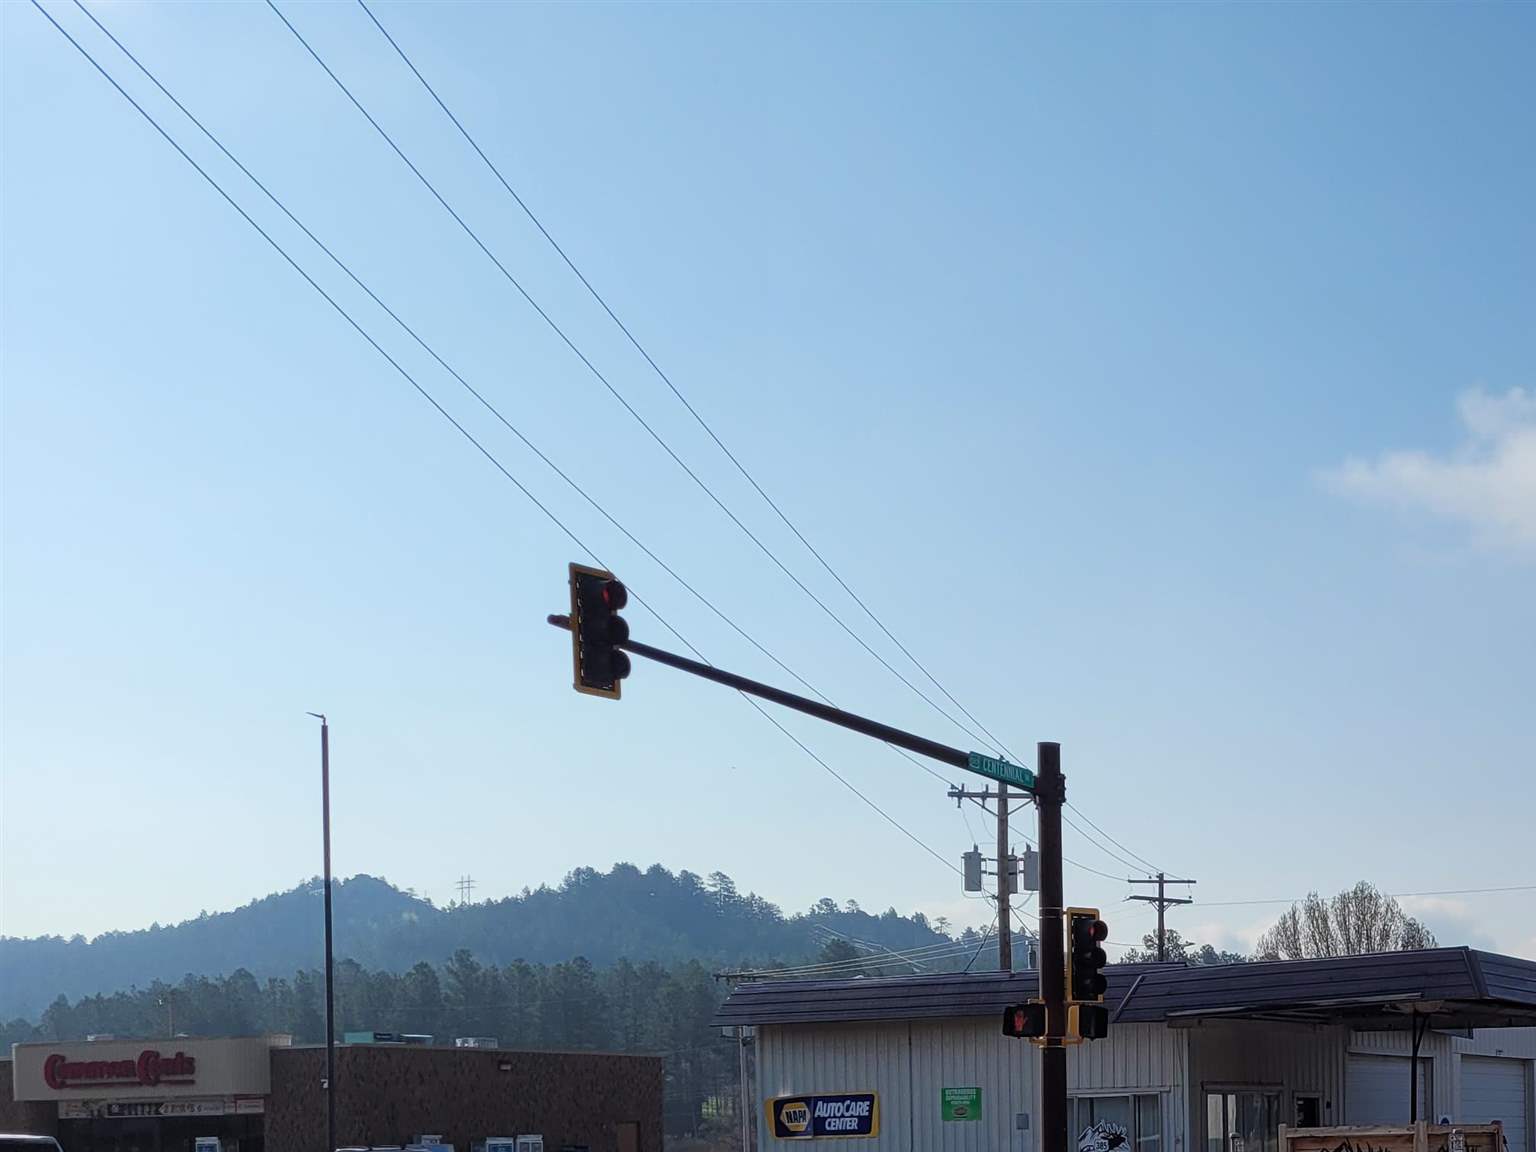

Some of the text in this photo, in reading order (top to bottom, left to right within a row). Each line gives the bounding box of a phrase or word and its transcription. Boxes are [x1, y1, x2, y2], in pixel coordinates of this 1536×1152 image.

[785, 1110, 807, 1124] NAPA
[825, 1118, 858, 1130] CENTER
[1095, 1141, 1107, 1150] 385
